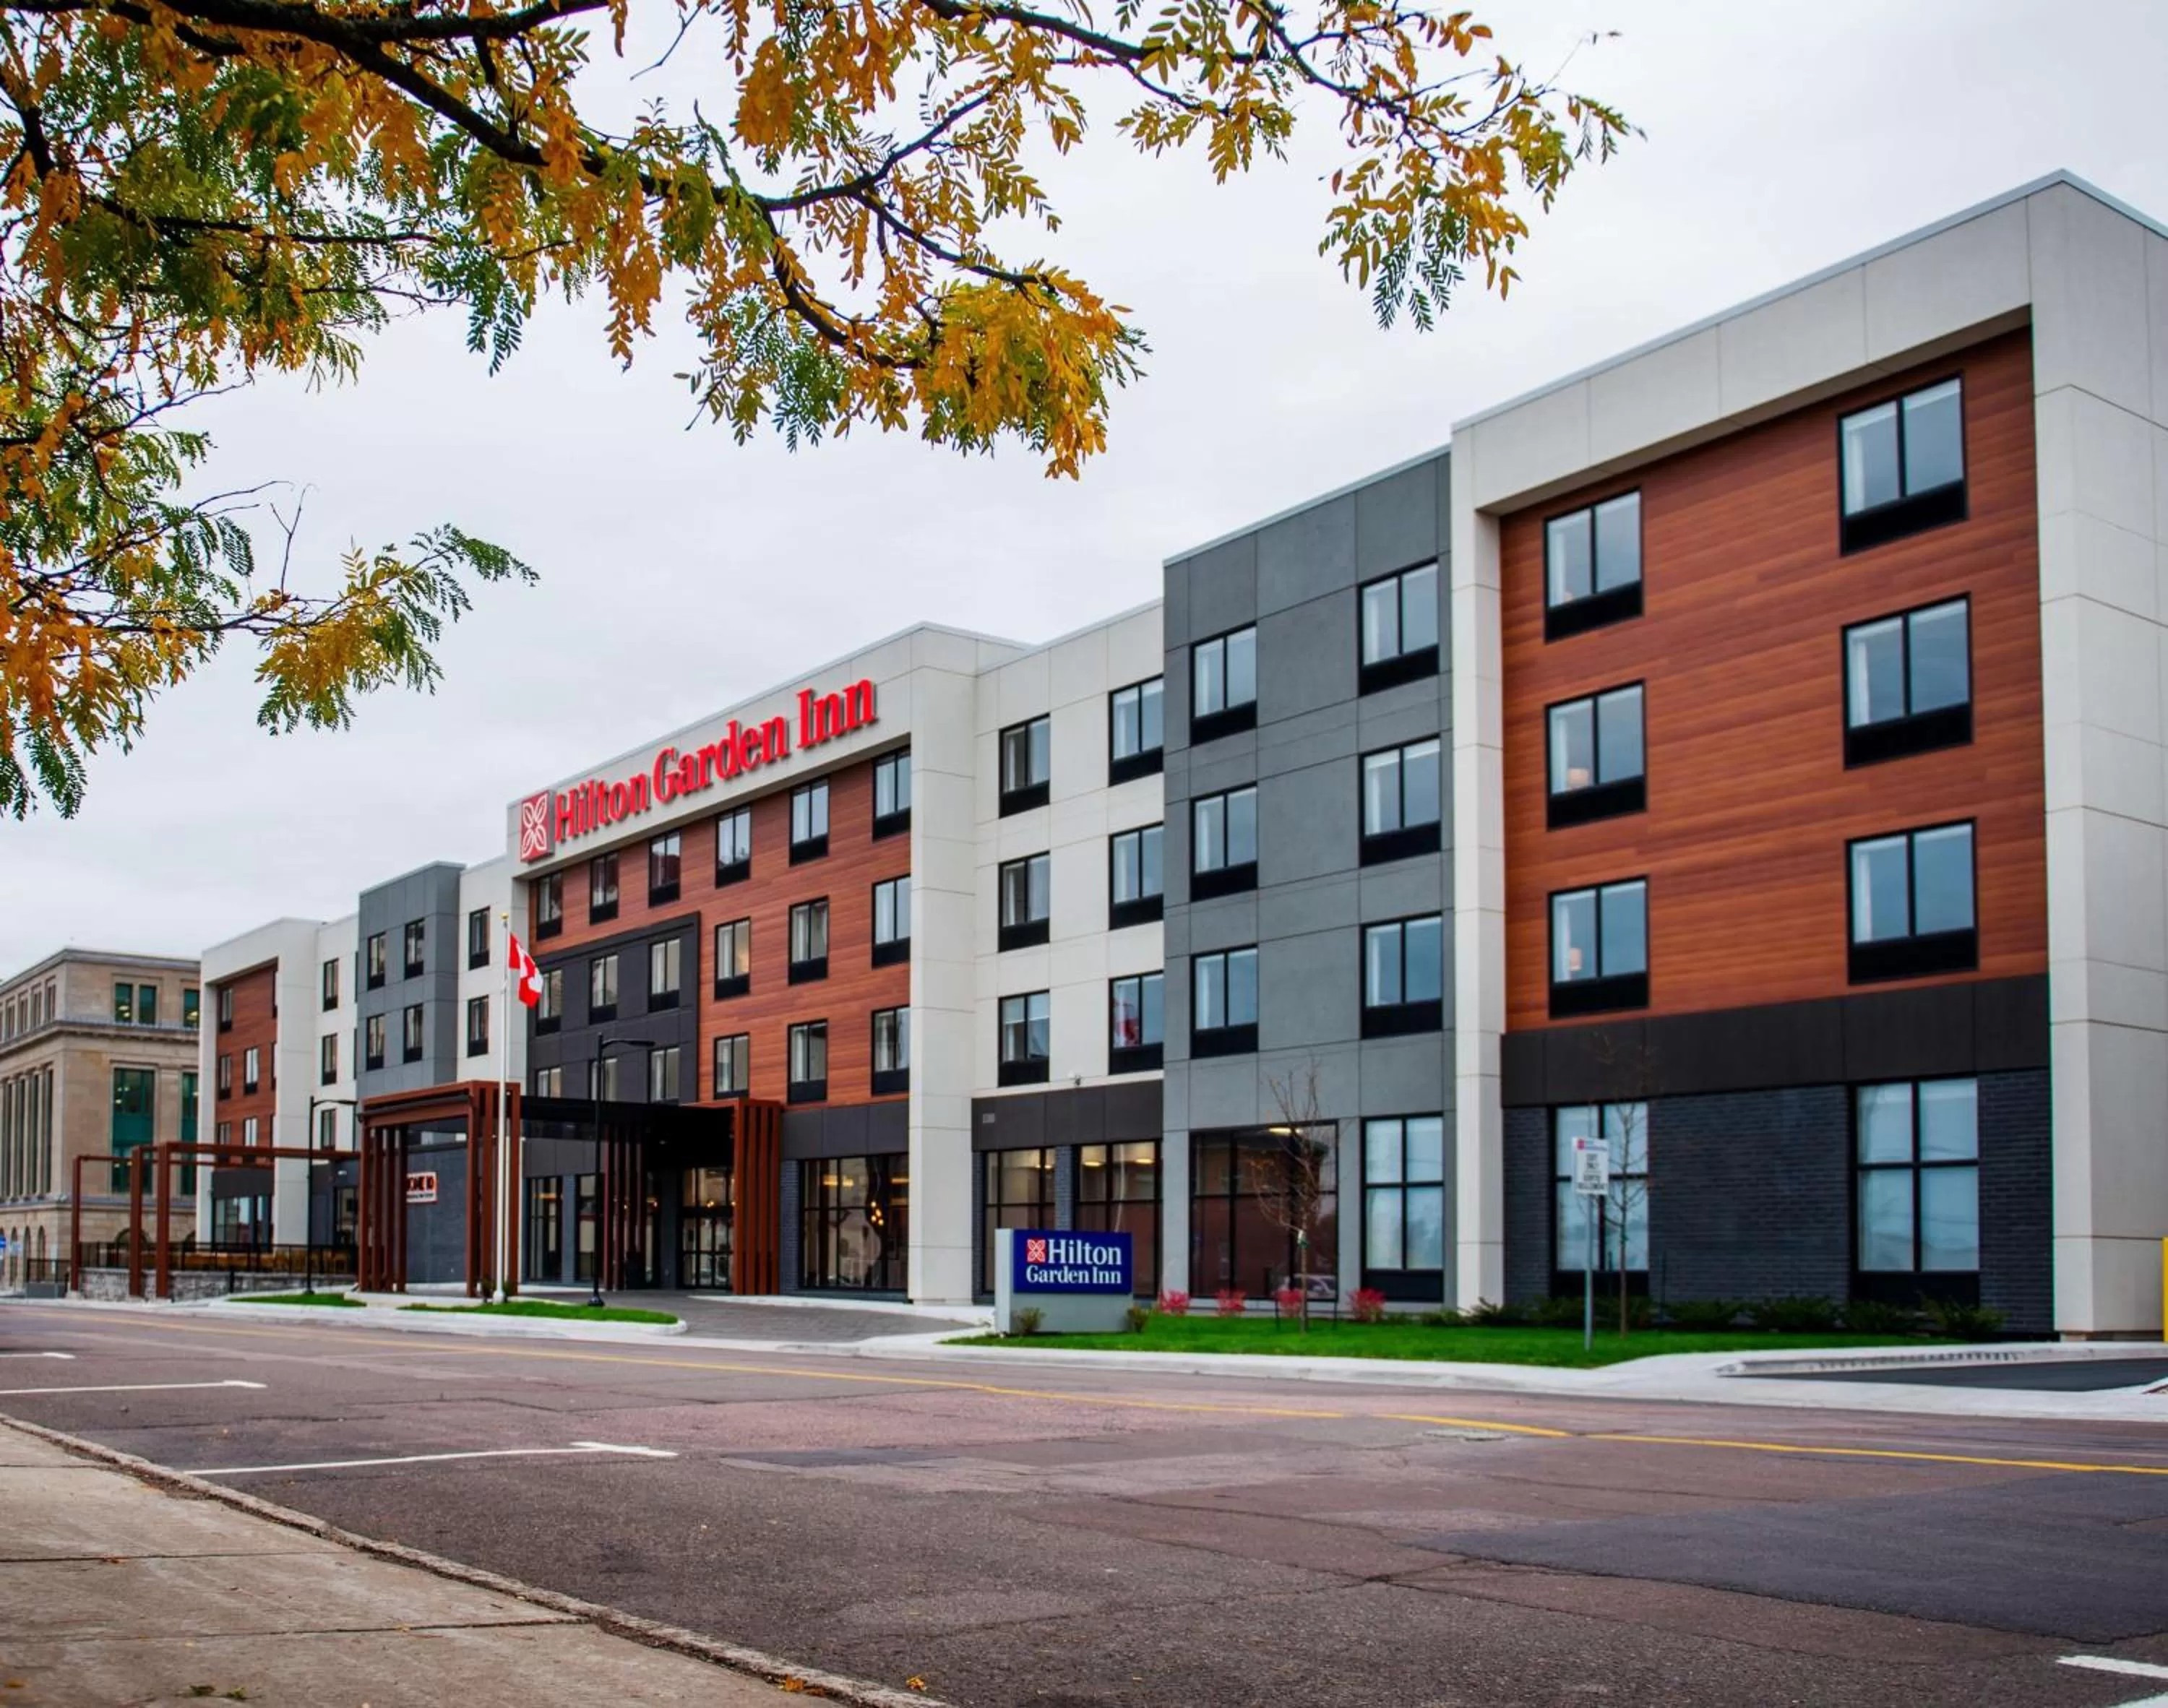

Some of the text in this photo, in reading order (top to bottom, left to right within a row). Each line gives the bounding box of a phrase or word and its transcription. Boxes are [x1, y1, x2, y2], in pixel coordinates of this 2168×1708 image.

[554, 678, 878, 842] Hilton Garden Inn
[1048, 1238, 1122, 1265] Hilton
[1025, 1264, 1122, 1284] Garden Inn
